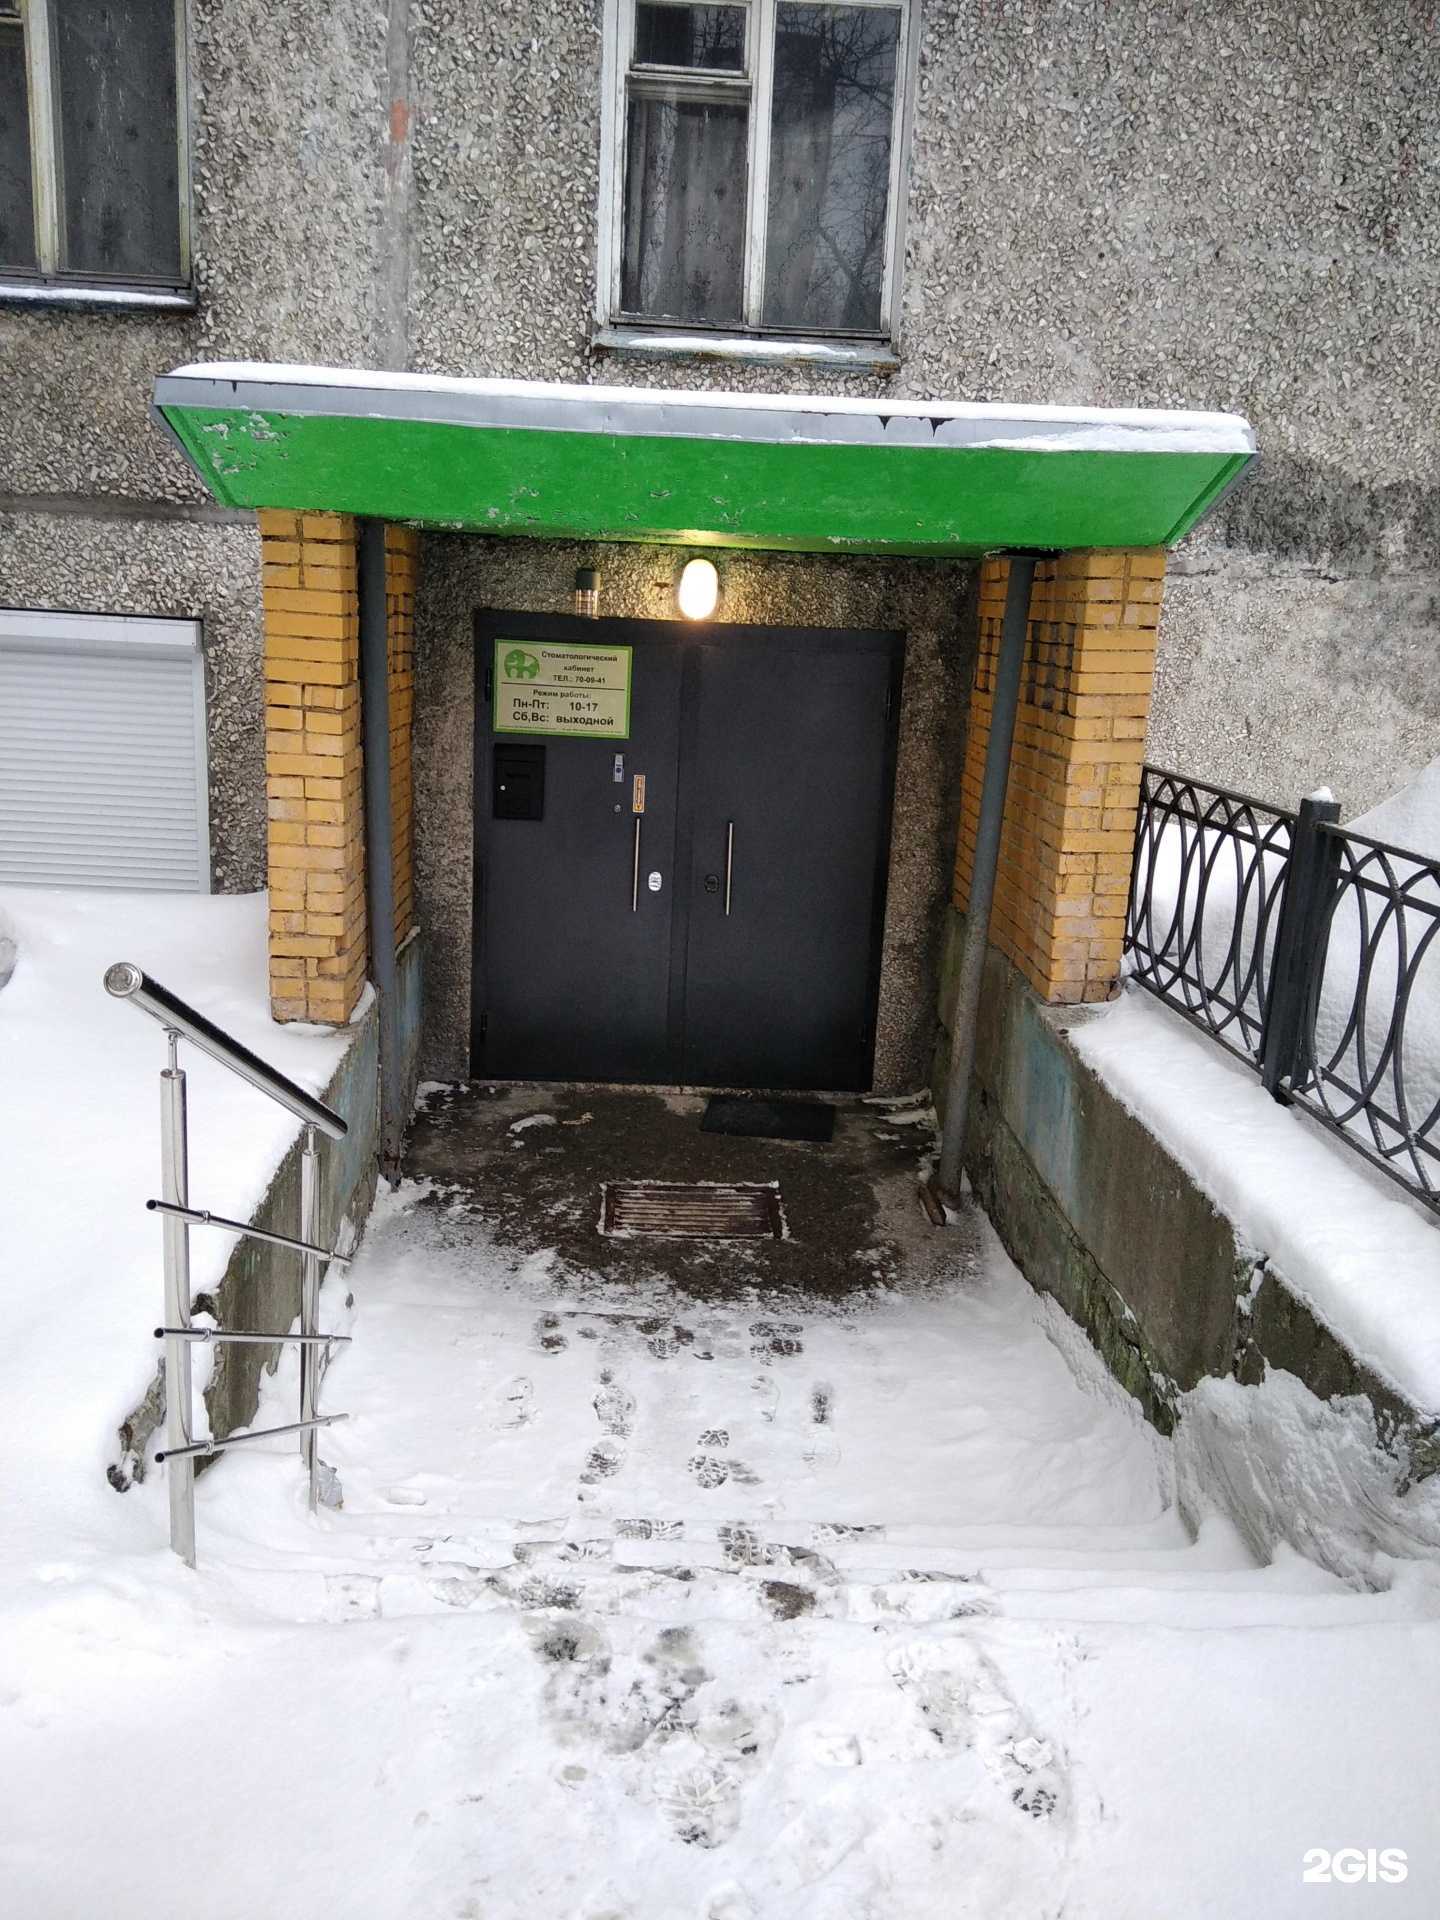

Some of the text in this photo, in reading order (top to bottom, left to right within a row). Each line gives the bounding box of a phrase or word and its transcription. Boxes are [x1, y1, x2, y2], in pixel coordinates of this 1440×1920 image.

[542, 651, 618, 662] Стоматологический
[564, 665, 594, 673] кабинет
[575, 676, 606, 684] 70-09-41
[533, 689, 558, 697] Режим
[513, 698, 599, 712] Пн-Пт: 10-17
[513, 711, 614, 726] Сб,Вс: выходной
